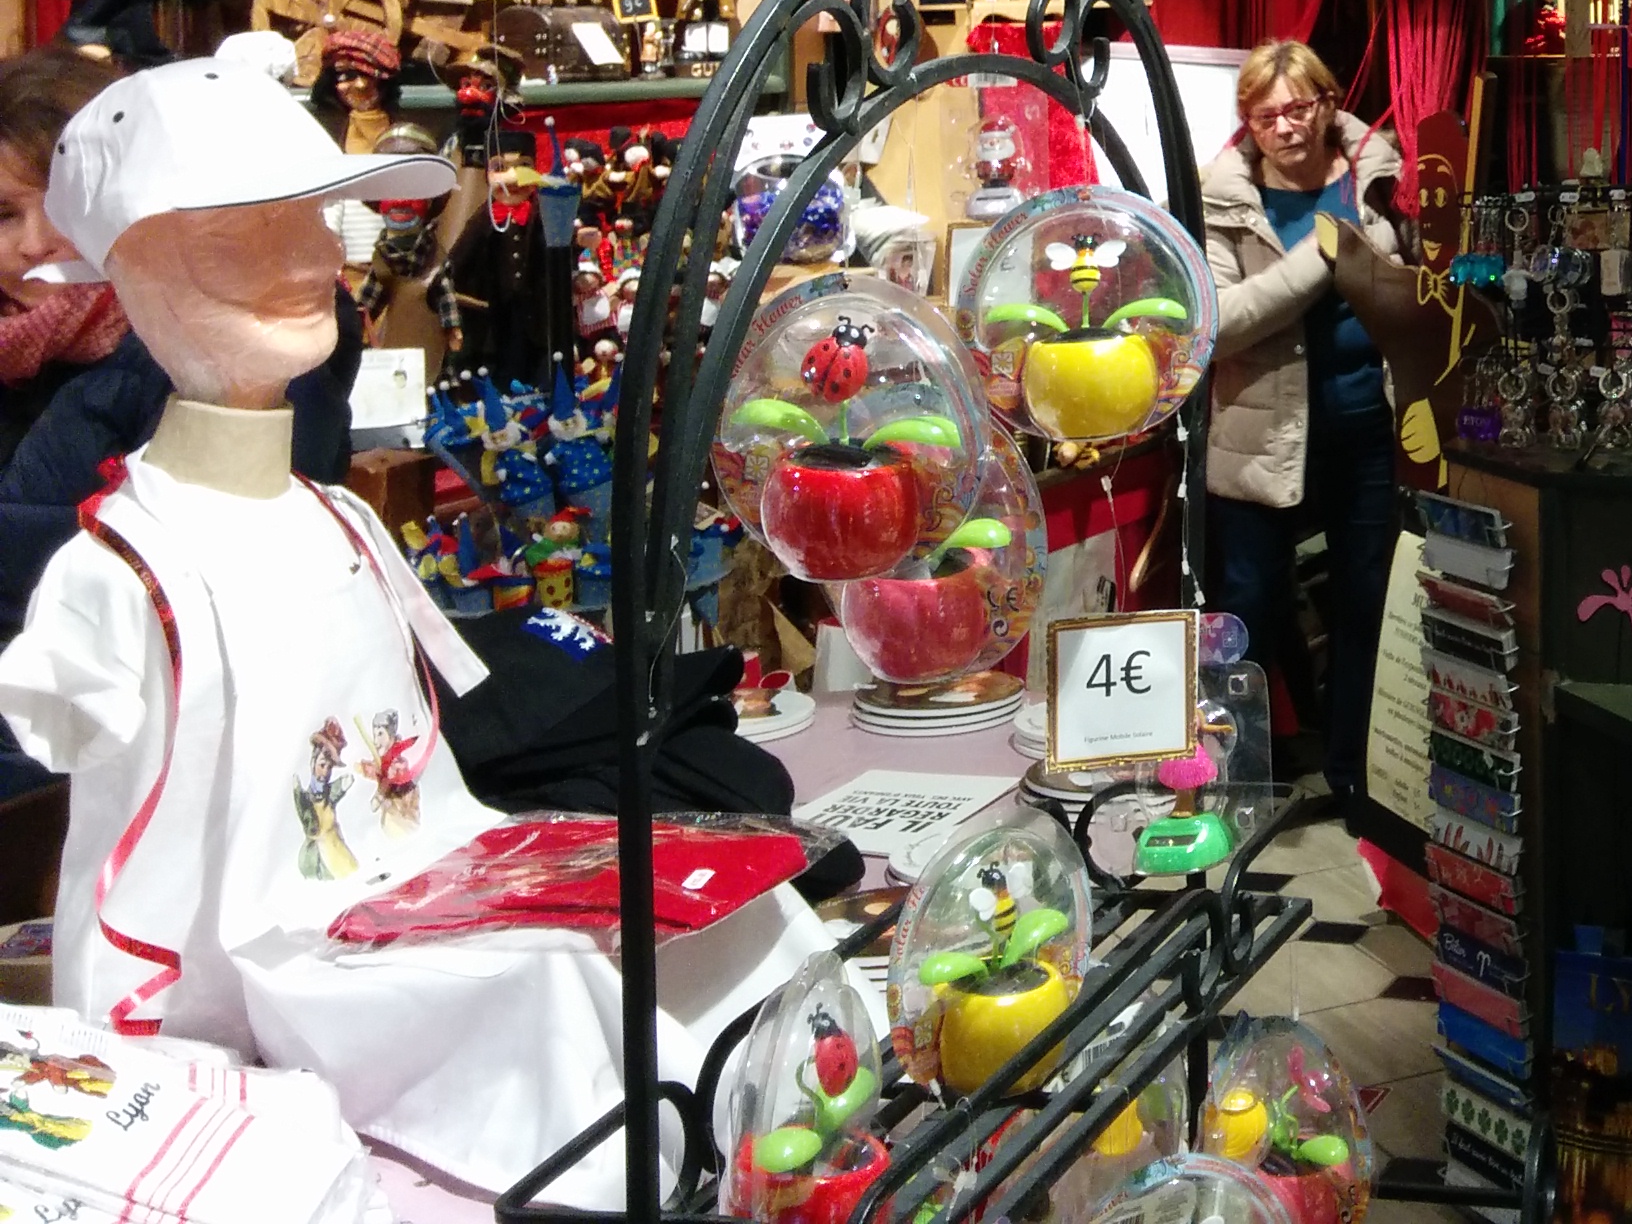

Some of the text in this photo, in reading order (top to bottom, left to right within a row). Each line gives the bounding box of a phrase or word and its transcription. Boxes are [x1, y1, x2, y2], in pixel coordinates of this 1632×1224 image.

[963, 212, 1029, 296] Solar Flower
[751, 295, 804, 337] Flower
[1085, 650, 1152, 698] 4€
[806, 811, 935, 834] IL FAUT
[821, 802, 952, 821] REGARDER
[838, 793, 964, 812] TOUTE LA VIE
[106, 1082, 161, 1132] Lyon
